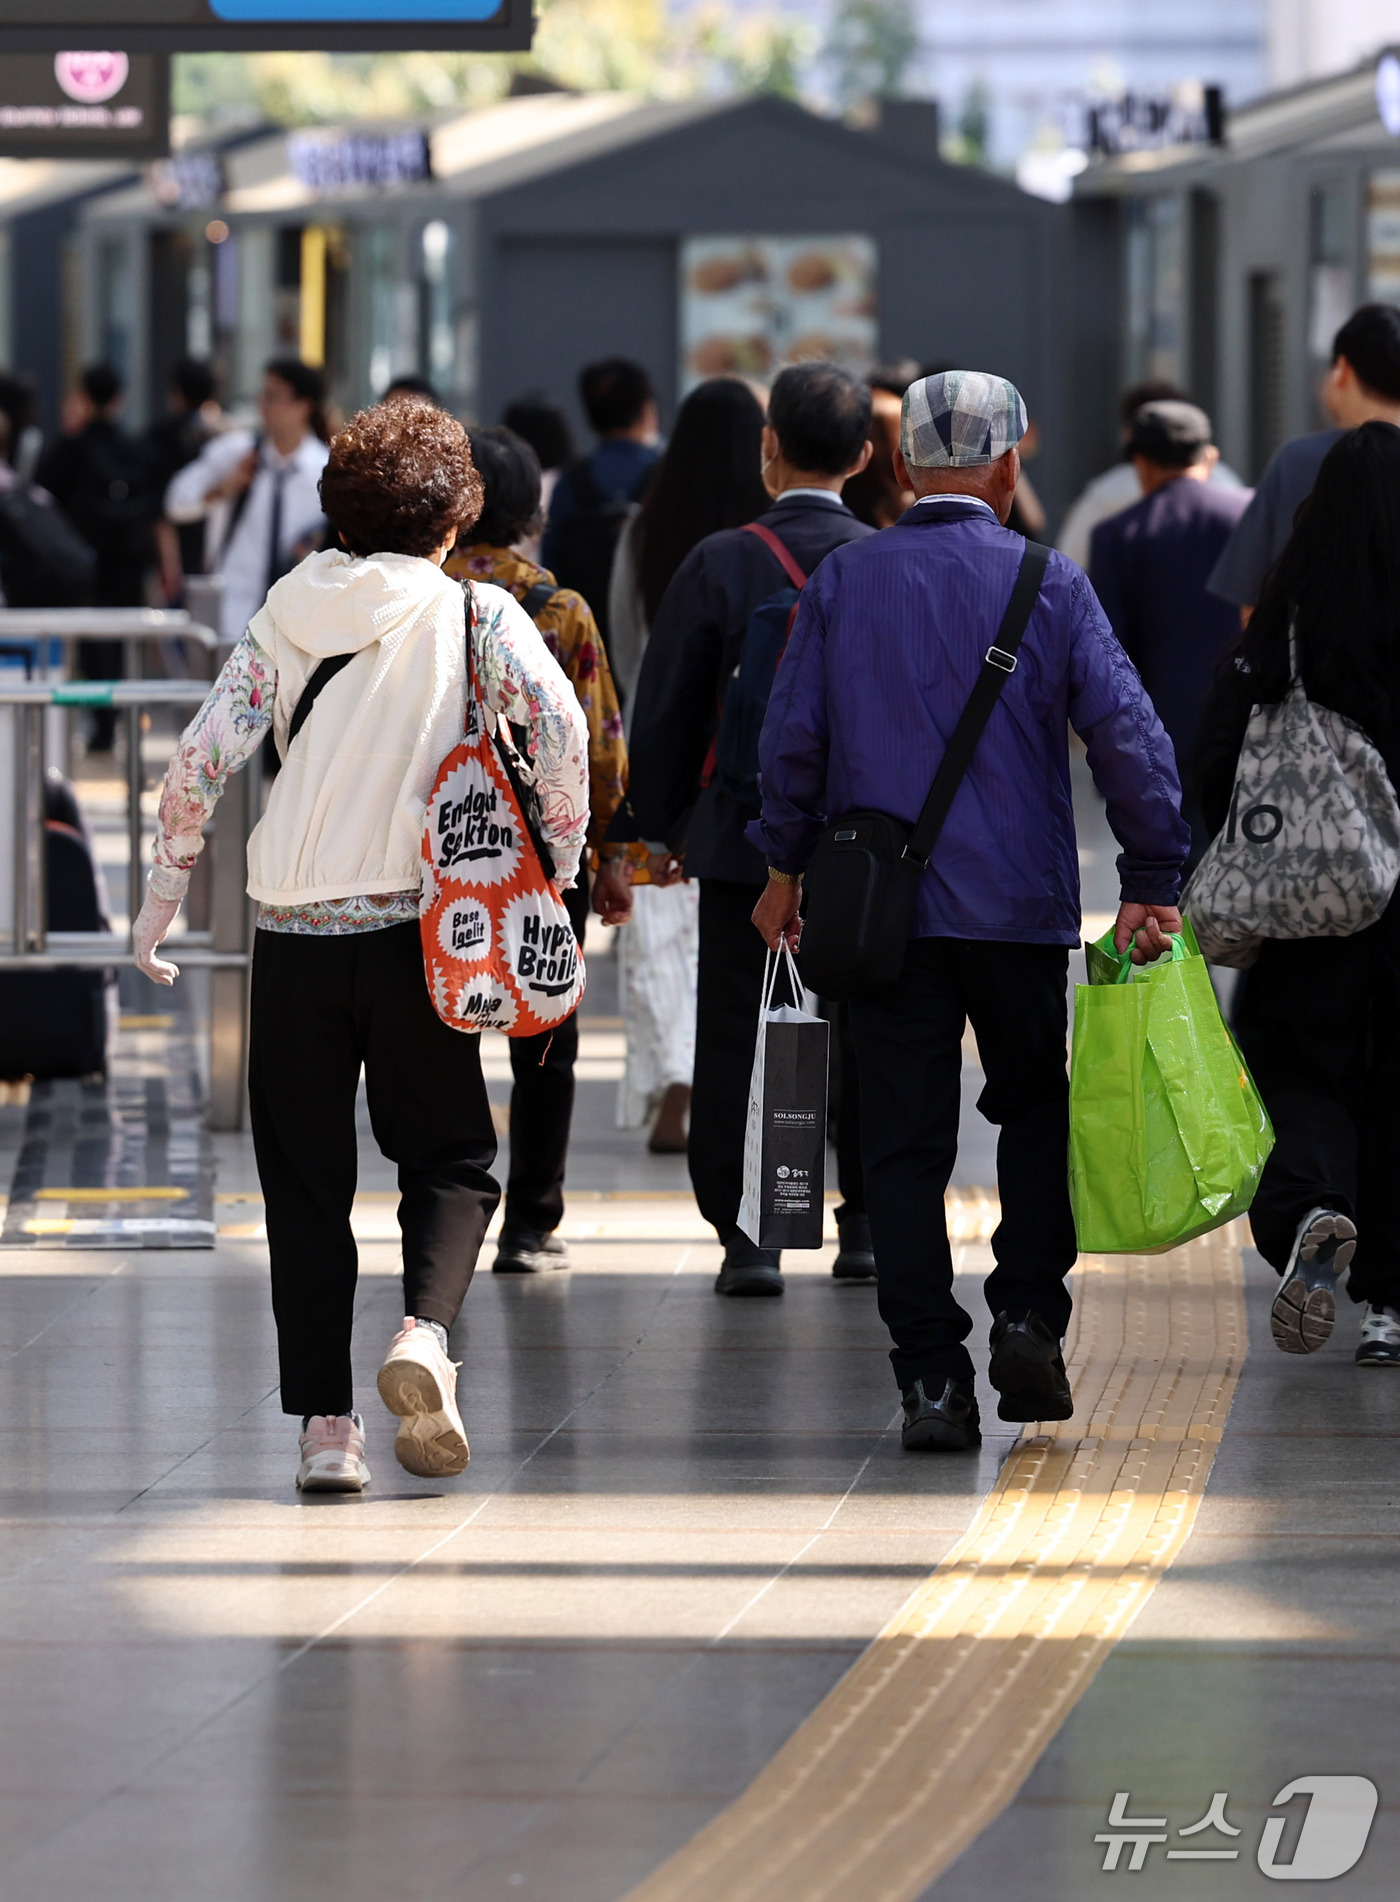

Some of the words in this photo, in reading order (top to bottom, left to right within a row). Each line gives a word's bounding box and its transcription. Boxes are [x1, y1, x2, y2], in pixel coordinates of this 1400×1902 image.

[452, 910, 479, 928] Base
[452, 921, 485, 947] Igelit
[773, 1112, 817, 1120] SOLSONGJU
